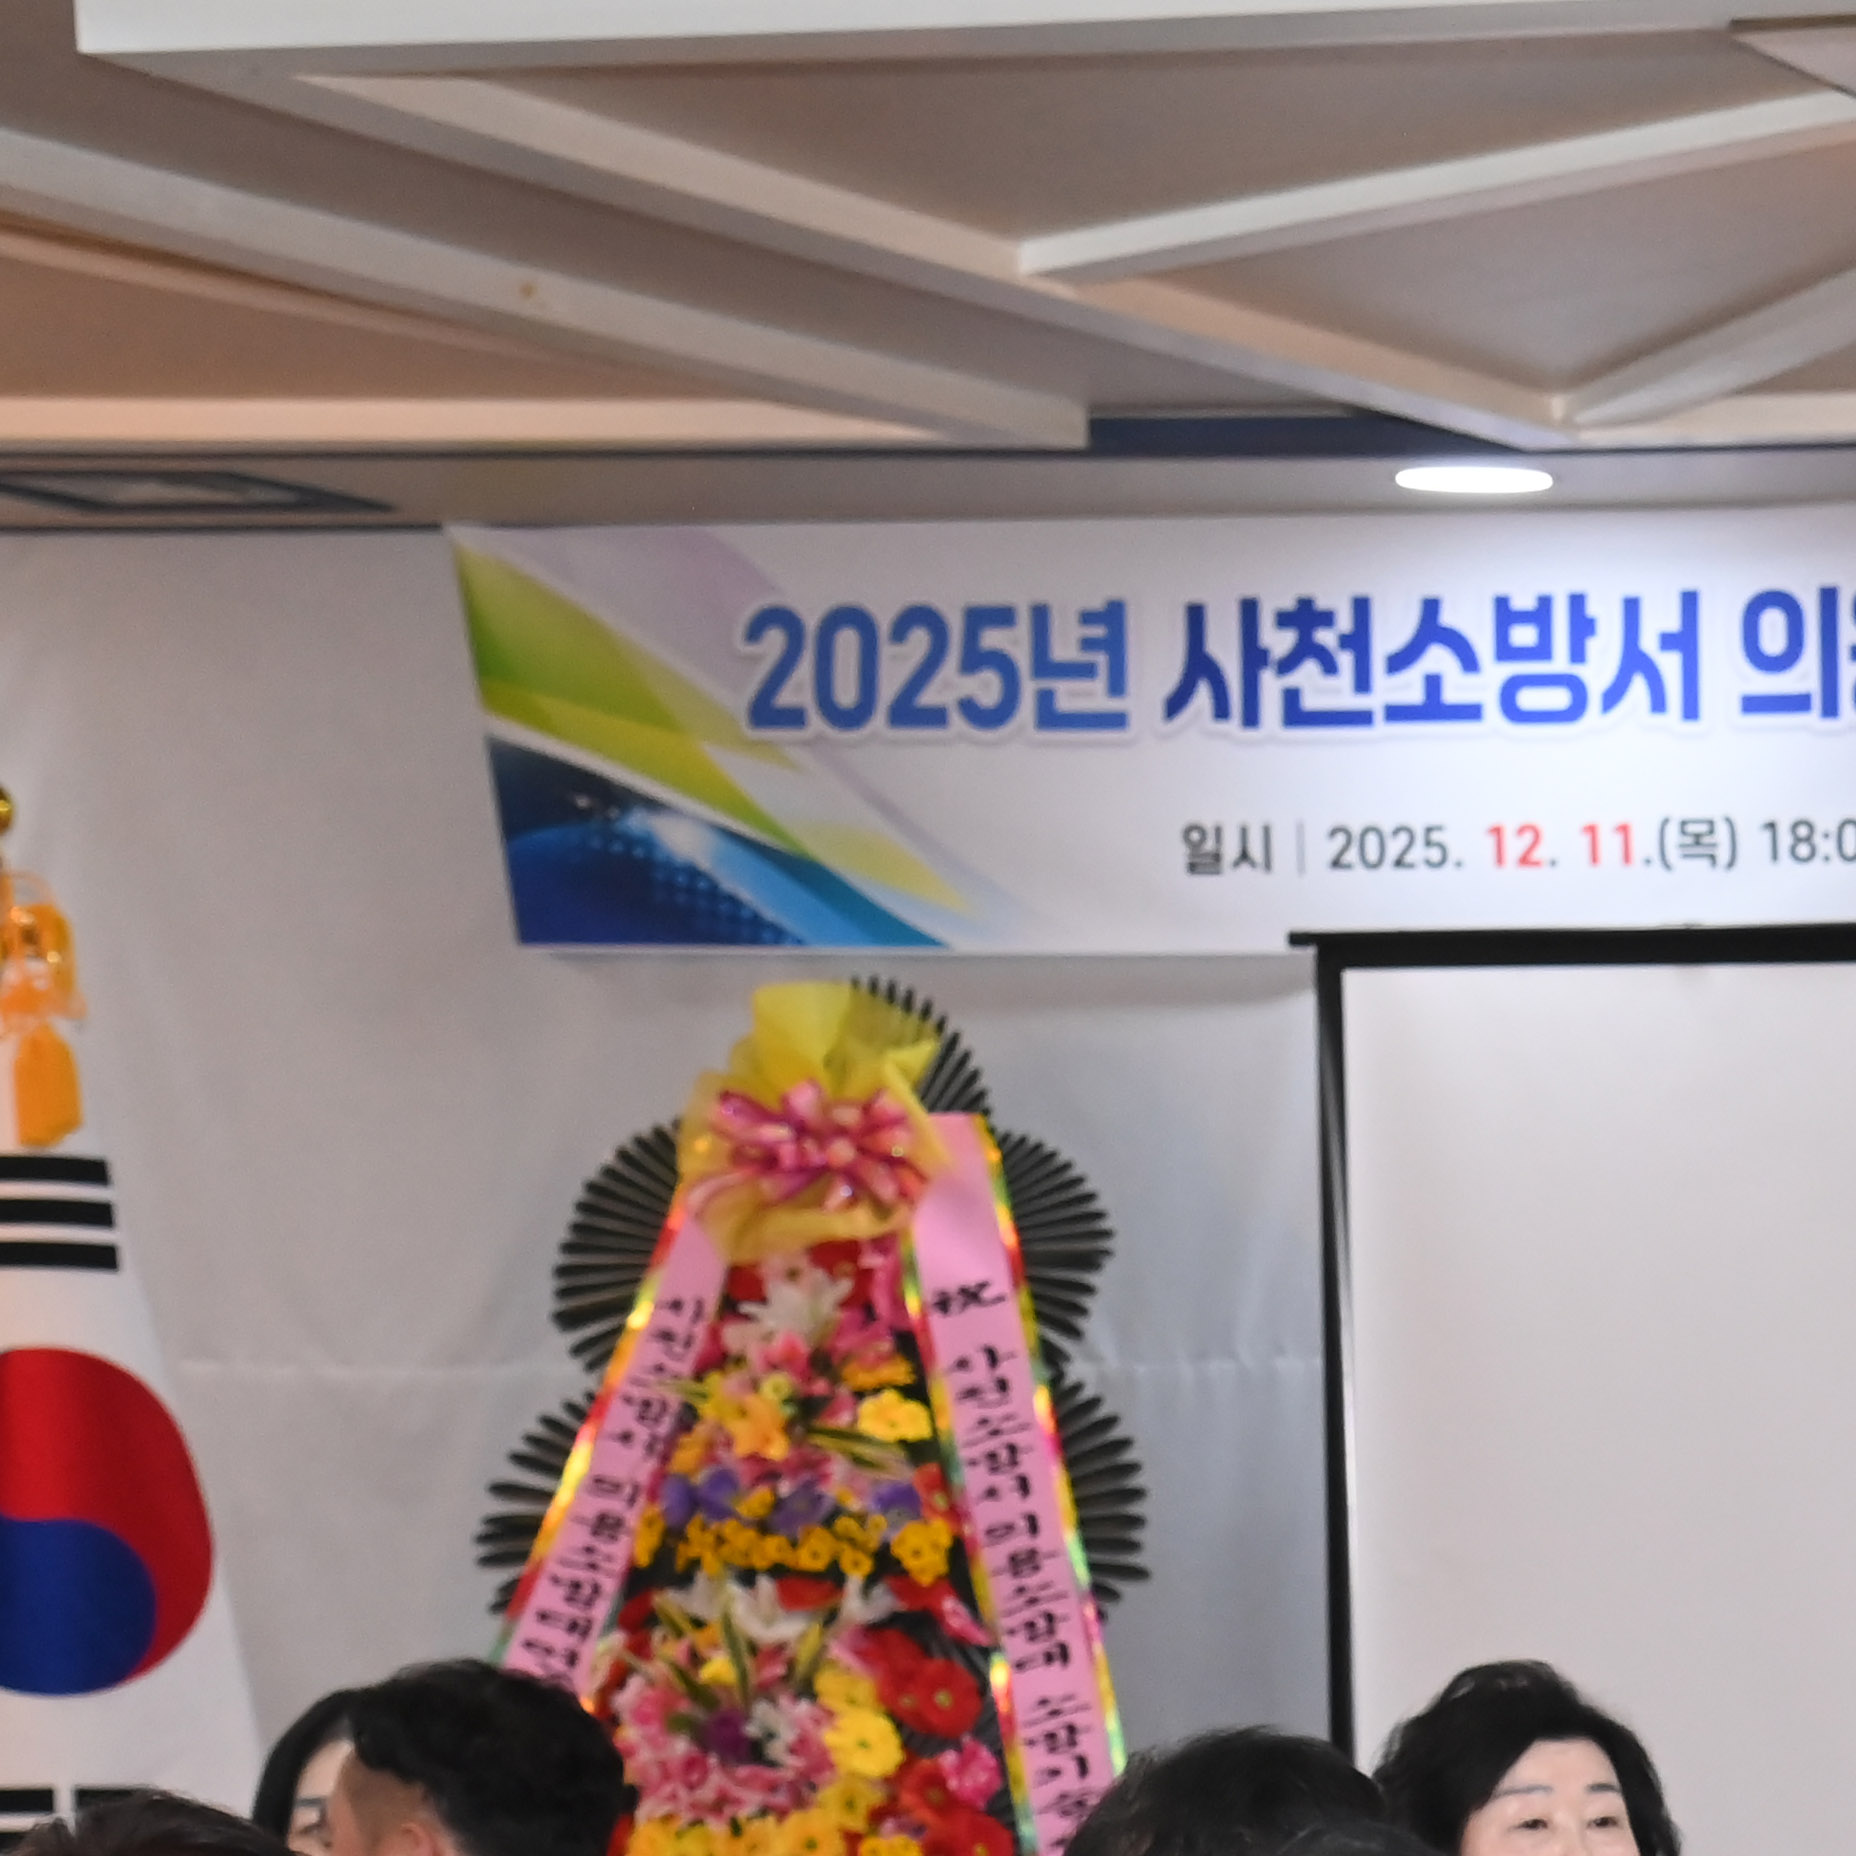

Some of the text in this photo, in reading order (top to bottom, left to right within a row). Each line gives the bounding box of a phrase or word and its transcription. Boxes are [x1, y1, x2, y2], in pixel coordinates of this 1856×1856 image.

[743, 598, 1130, 736] 2025년
[1161, 592, 1702, 730] 사천소방서
[1180, 822, 1274, 877] 일시
[1327, 824, 1463, 871] 2025.
[1486, 823, 1558, 869] 12.
